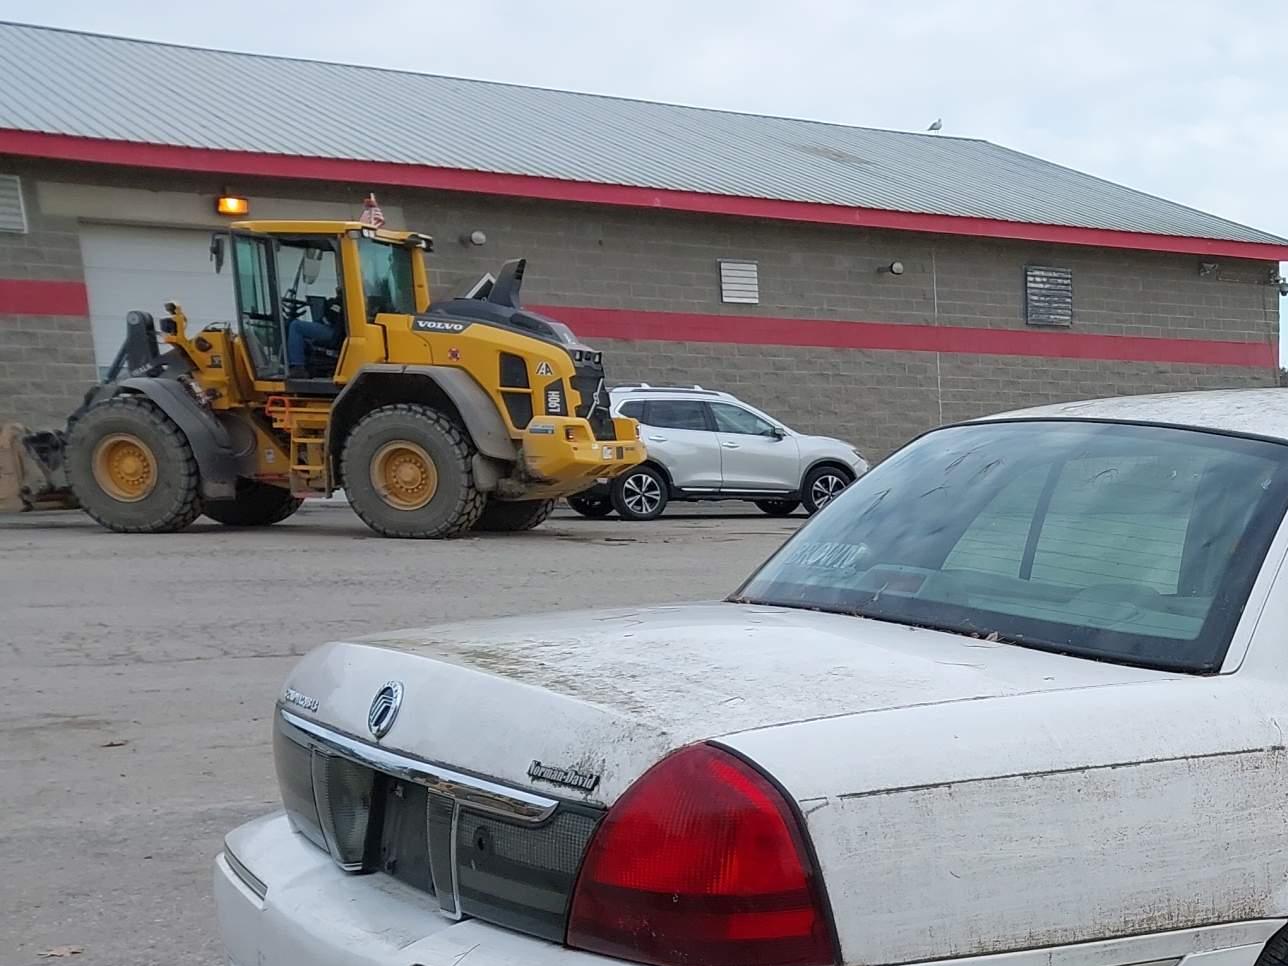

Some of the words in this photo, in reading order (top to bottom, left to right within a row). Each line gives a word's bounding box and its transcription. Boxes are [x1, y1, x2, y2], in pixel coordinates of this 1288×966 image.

[416, 320, 463, 331] VOLVO
[547, 391, 561, 412] L90H
[528, 760, 598, 790] Norman-David
